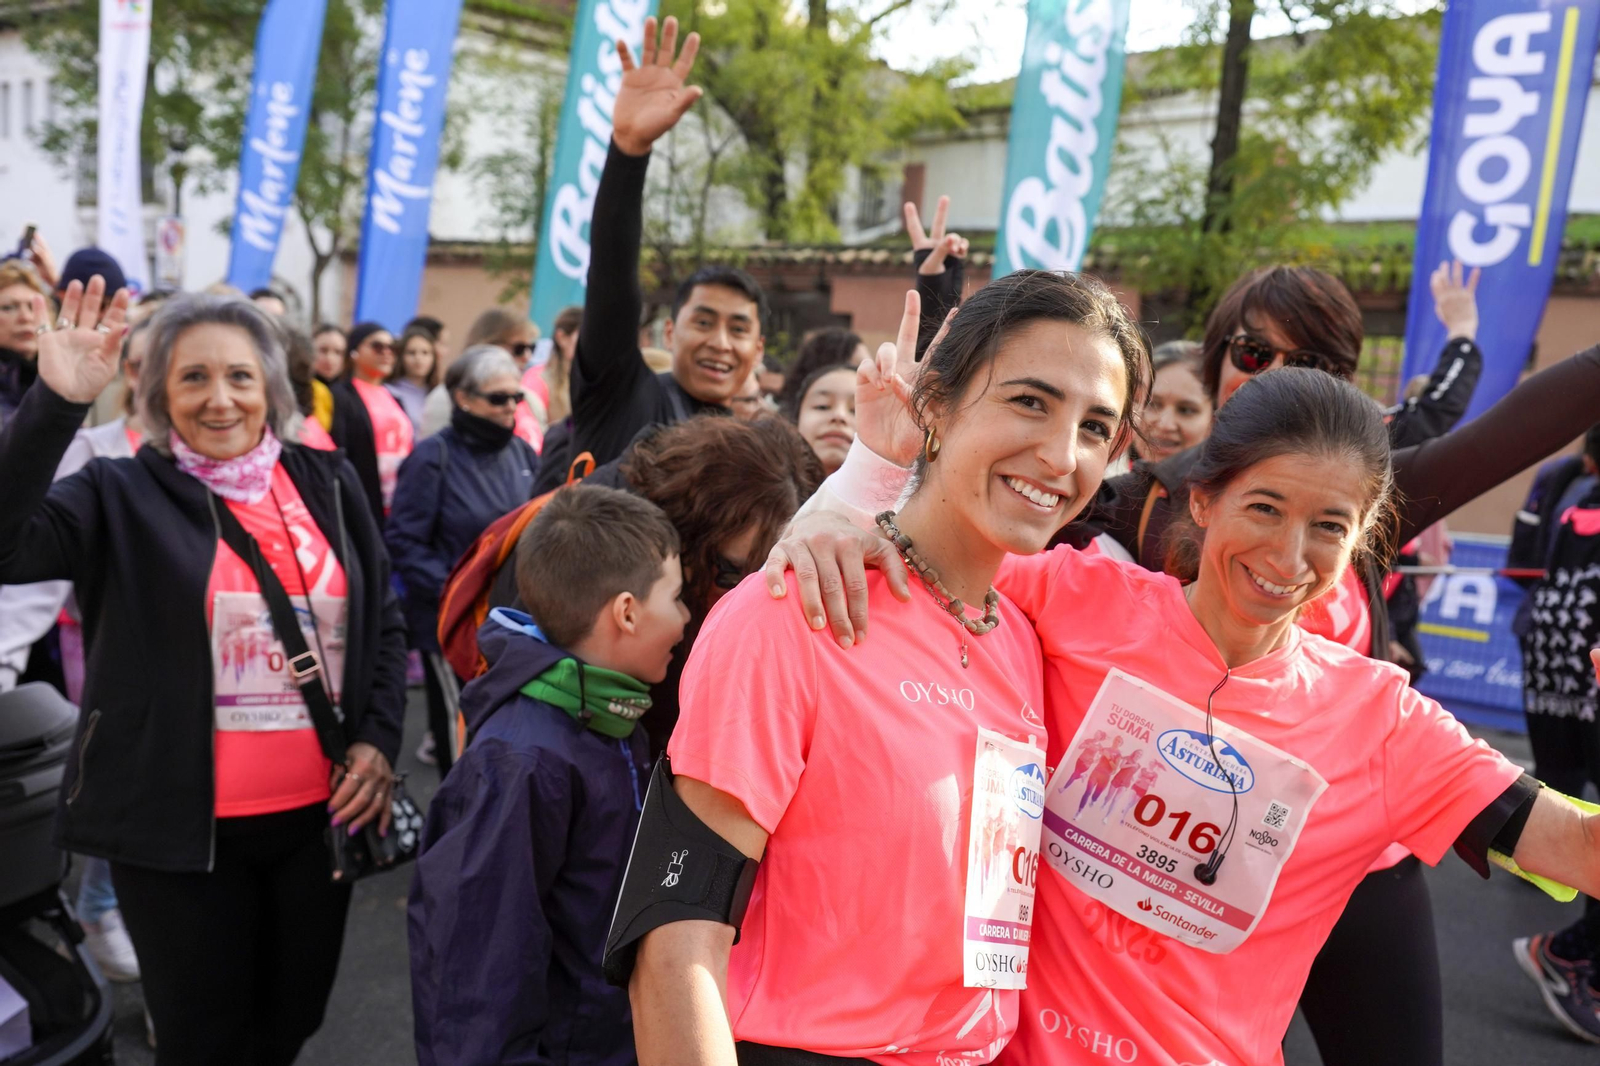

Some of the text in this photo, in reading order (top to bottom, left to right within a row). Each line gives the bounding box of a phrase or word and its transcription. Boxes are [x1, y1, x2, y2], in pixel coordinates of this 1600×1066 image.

[239, 81, 298, 251] Marlene
[370, 48, 436, 234] Marlene
[1447, 11, 1553, 267] GOYA
[1106, 713, 1150, 744] SUMA
[1110, 703, 1156, 732] TU DORSAL
[1162, 736, 1245, 790] ASTURIANA
[1133, 794, 1222, 854] 016
[1149, 834, 1175, 851] VIOLENCIA
[1048, 842, 1114, 889] OYSHO
[1064, 828, 1226, 917] CARRERA DE LA MUJER SEVILLA
[1136, 844, 1179, 873] 3895
[979, 923, 1011, 939] CARRERA
[1084, 899, 1170, 966] 2025
[1152, 903, 1218, 940] Santander
[1039, 1008, 1138, 1064] OYSHO
